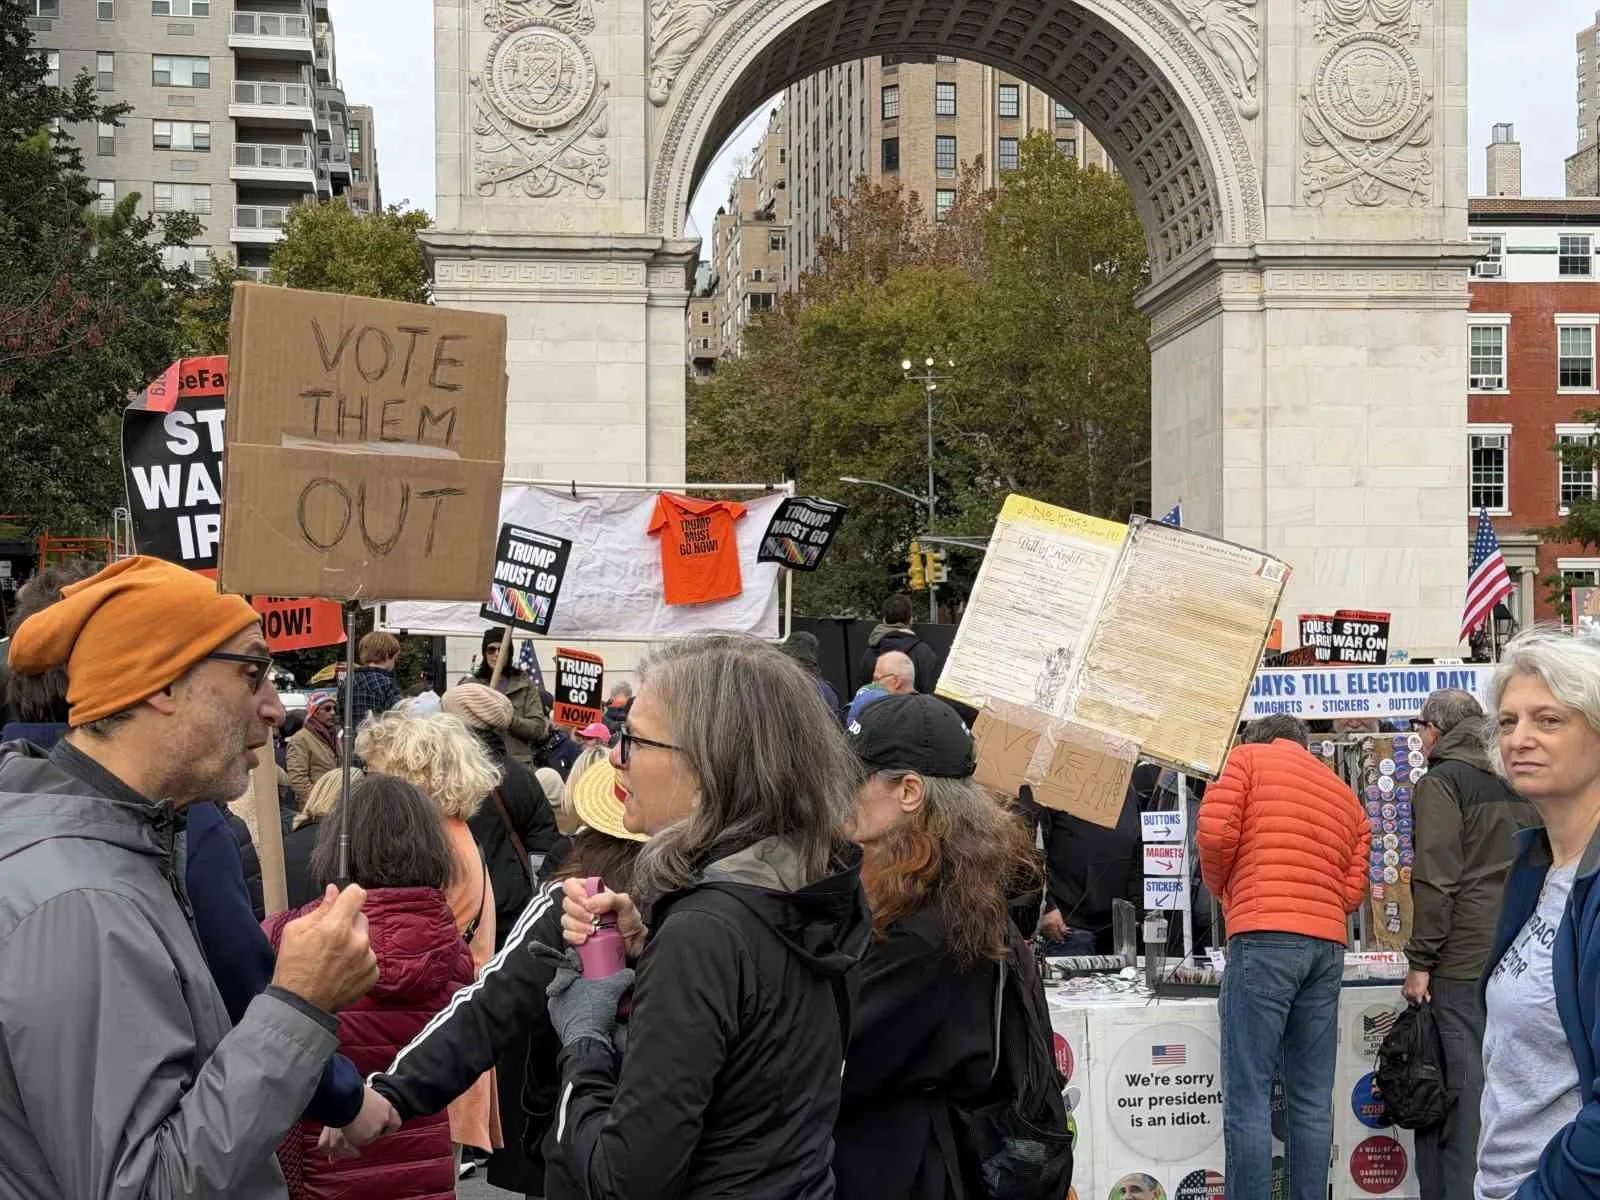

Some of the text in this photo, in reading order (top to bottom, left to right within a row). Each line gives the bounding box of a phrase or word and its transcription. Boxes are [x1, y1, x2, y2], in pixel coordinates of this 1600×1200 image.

[310, 317, 472, 392] VOTE
[298, 388, 458, 447] THEM
[163, 409, 226, 456] ST
[131, 461, 223, 510] WA
[297, 477, 466, 559] OUT
[680, 516, 712, 532] TRUMP
[784, 505, 832, 528] TRUMP
[684, 528, 710, 543] MUST
[770, 520, 829, 545] MUST GO
[507, 540, 557, 569] TRUMP
[680, 539, 719, 556] GO NOW!
[494, 560, 557, 594] MUST GO
[1343, 622, 1380, 636] STOP
[1332, 634, 1387, 651] WAR ON
[1340, 648, 1377, 663] IRAN!
[558, 656, 602, 677] TRUMP
[561, 672, 598, 692] MUST
[1302, 673, 1340, 695] TILL
[1347, 671, 1429, 694] ELECTION
[569, 688, 588, 705] GO
[1254, 700, 1303, 713] MAGNETS
[1322, 699, 1369, 712] STICKERS
[560, 706, 596, 724] NOW!
[1143, 814, 1181, 826] BUTTONS
[1146, 847, 1184, 859] MAGNETS
[1146, 881, 1184, 892] STICKERS
[1124, 1072, 1214, 1088] We're sorry
[1117, 1091, 1223, 1110] our president
[1130, 1111, 1211, 1127] is an idiot.
[1181, 1185, 1225, 1194] IMMIGRANT
